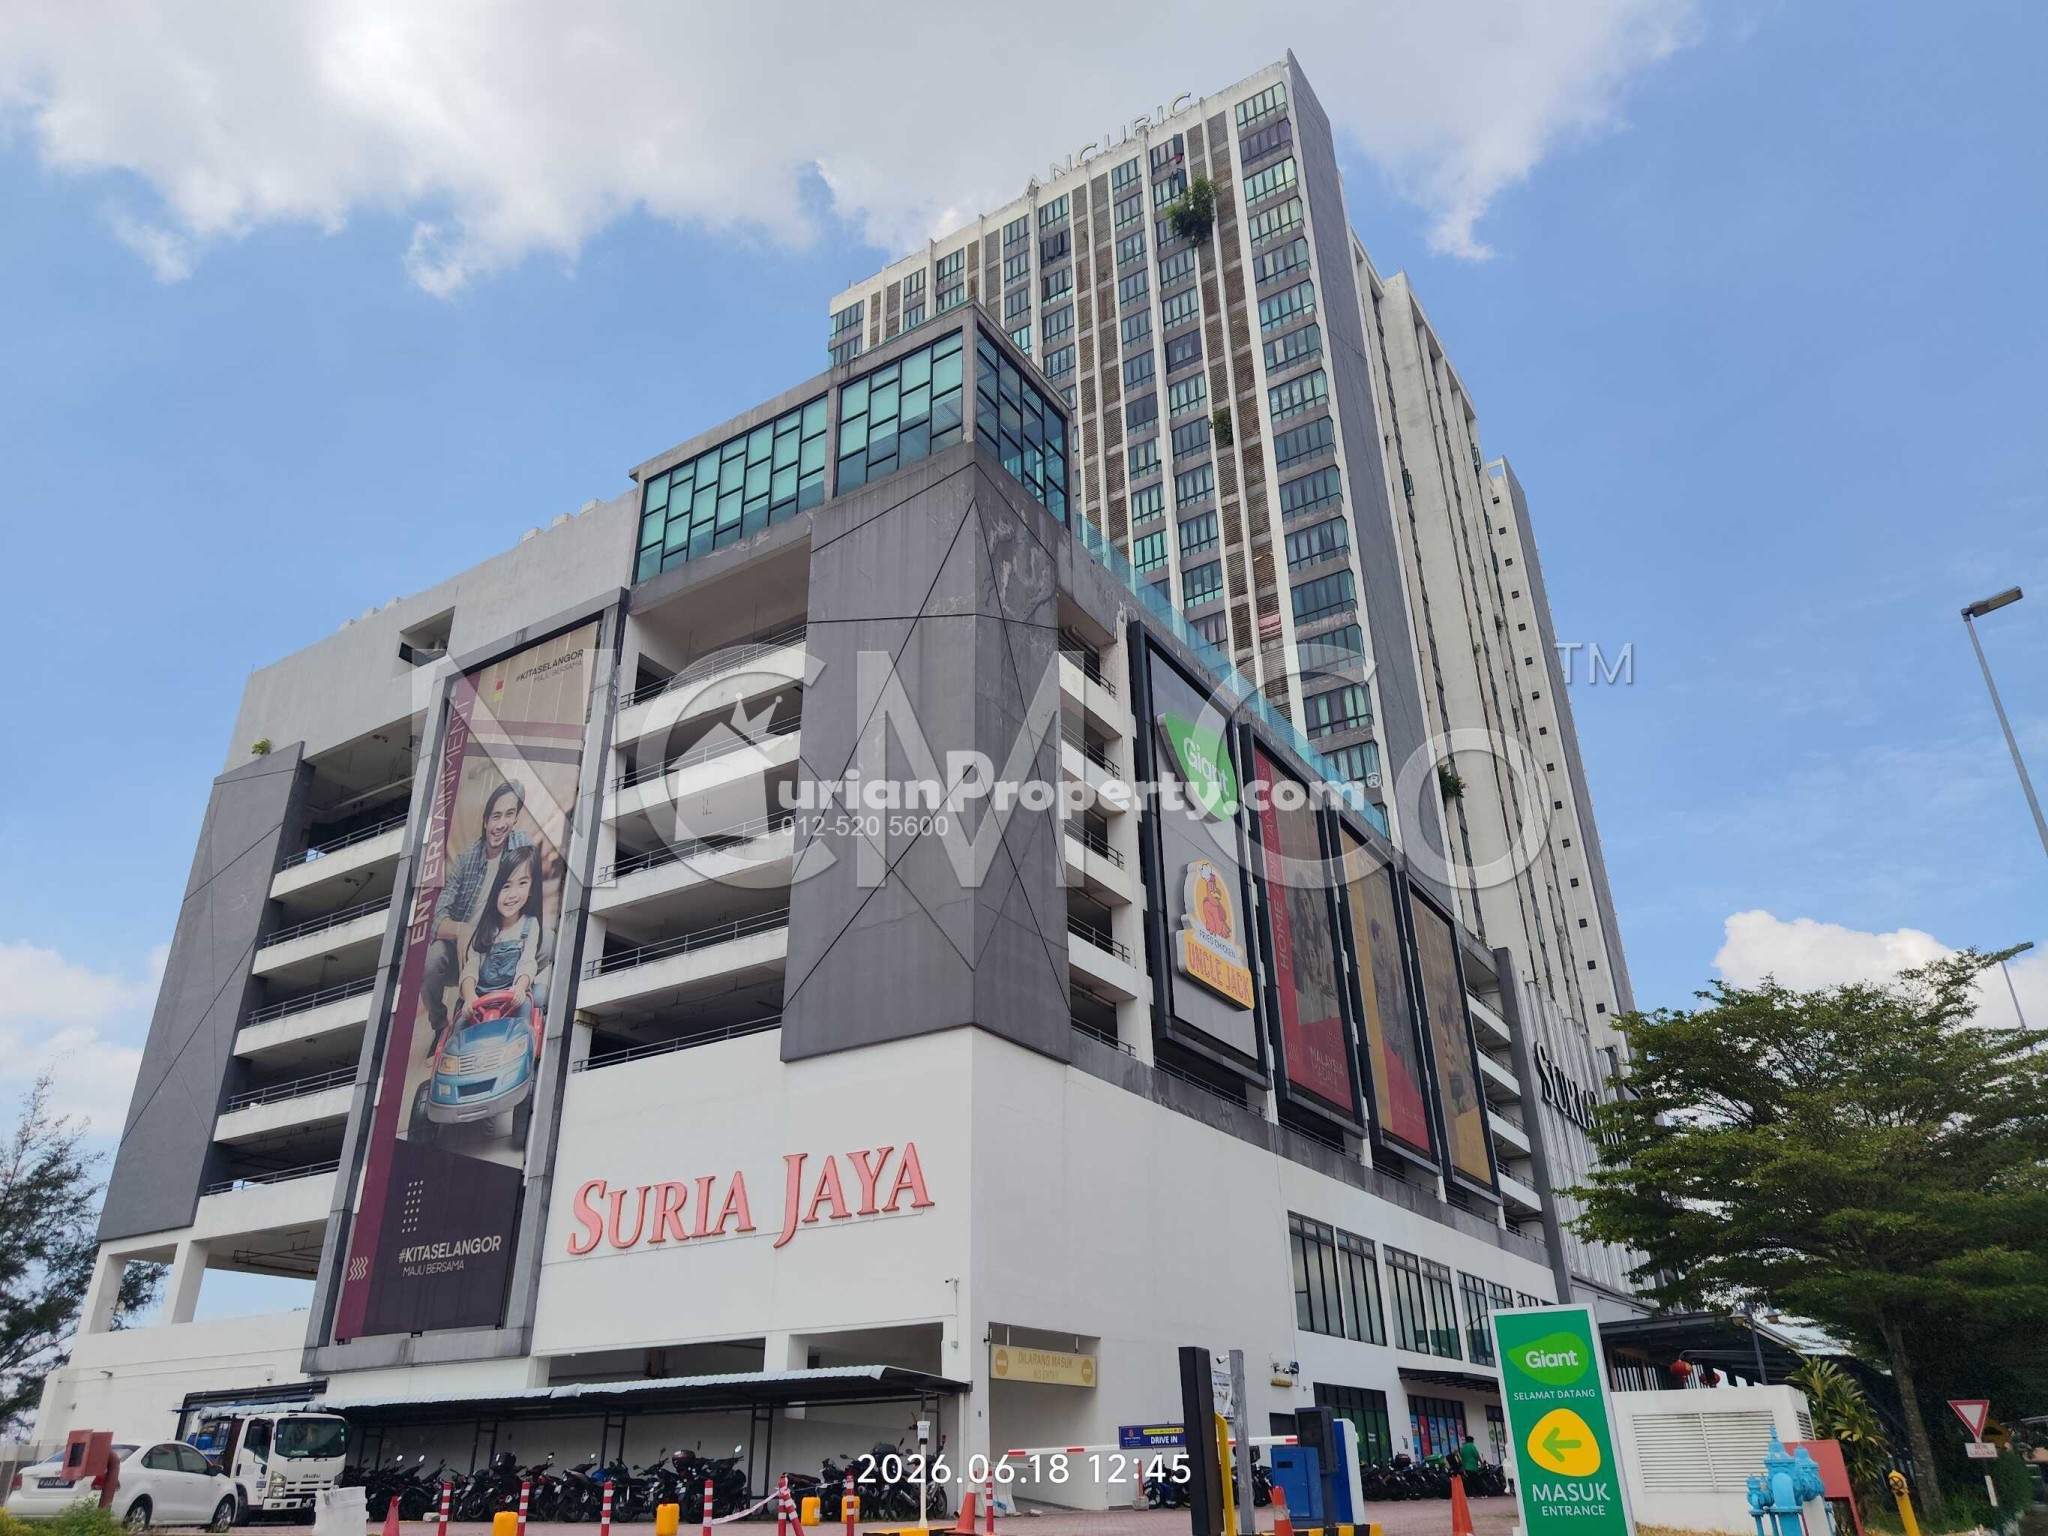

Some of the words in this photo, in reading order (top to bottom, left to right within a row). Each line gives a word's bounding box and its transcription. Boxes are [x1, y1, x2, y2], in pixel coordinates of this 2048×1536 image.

[516, 649, 584, 682] #KITASELANGOR
[1183, 736, 1230, 797] Giant
[410, 699, 471, 944] ENTERTAINMENT
[1199, 929, 1214, 947] FRIED
[1214, 937, 1236, 960] CHICKEN
[1273, 902, 1290, 969] HOME
[1188, 942, 1223, 987] UNCLE
[1226, 965, 1251, 1000] JACK
[567, 1170, 757, 1255] SURIA
[773, 1142, 935, 1248] JAYA
[399, 1235, 502, 1263] #KITASELANGOR
[402, 1264, 426, 1277] MAJU
[426, 1260, 465, 1275] BERSAMA
[1018, 1351, 1051, 1368] DILARANG
[1052, 1355, 1074, 1369] MASUK
[1526, 1349, 1579, 1369] Giant
[1513, 1390, 1554, 1401] SELAMAT
[1557, 1388, 1596, 1400] DATANG
[1150, 1436, 1169, 1445] DRIVE
[1170, 1435, 1178, 1444] IN
[1532, 1482, 1611, 1502] MASUK
[1541, 1504, 1606, 1517] ENTRANCE
